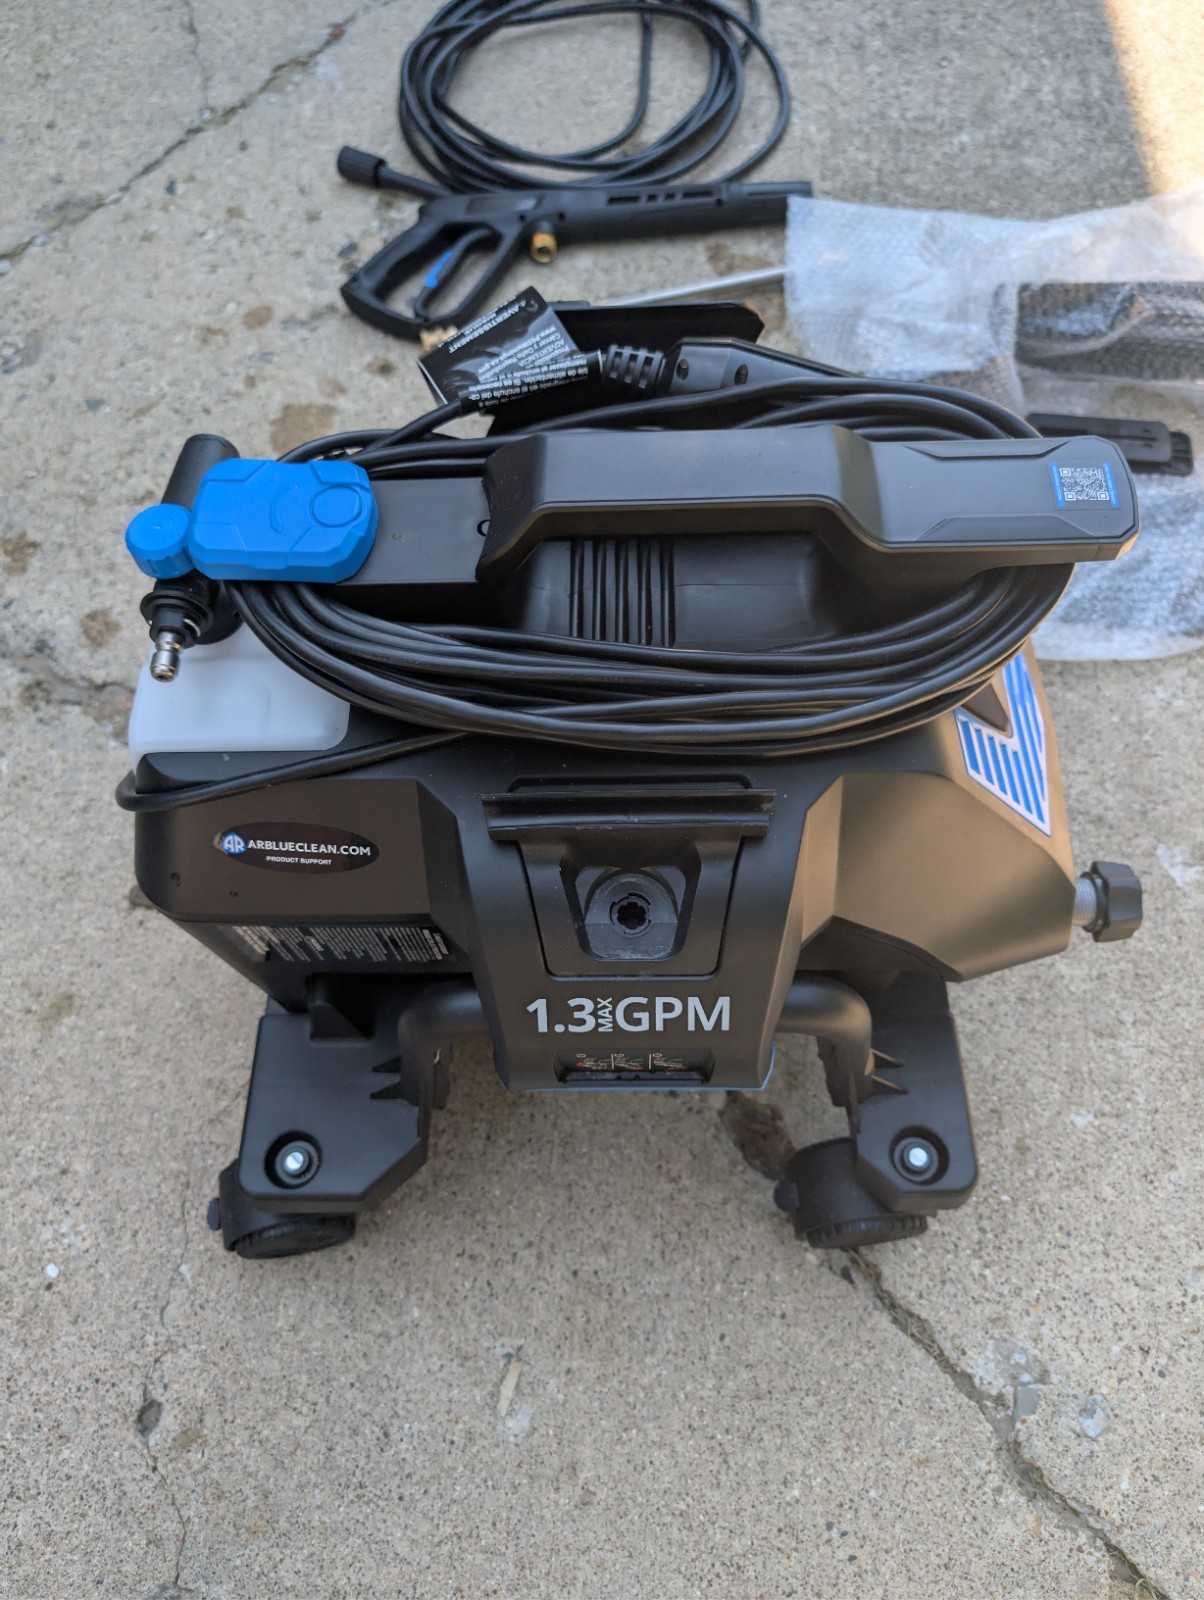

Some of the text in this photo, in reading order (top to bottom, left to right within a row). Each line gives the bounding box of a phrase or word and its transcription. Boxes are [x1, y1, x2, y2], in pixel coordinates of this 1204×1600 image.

[447, 303, 520, 353] AVERTISSEMENT
[538, 332, 561, 348] Cáncer
[517, 338, 565, 367] ADVERTENCIA
[493, 387, 520, 396] enchufe
[248, 840, 371, 856] ARBLUECLEAN.COM
[526, 996, 730, 1033] 1.3 MAX GPM
